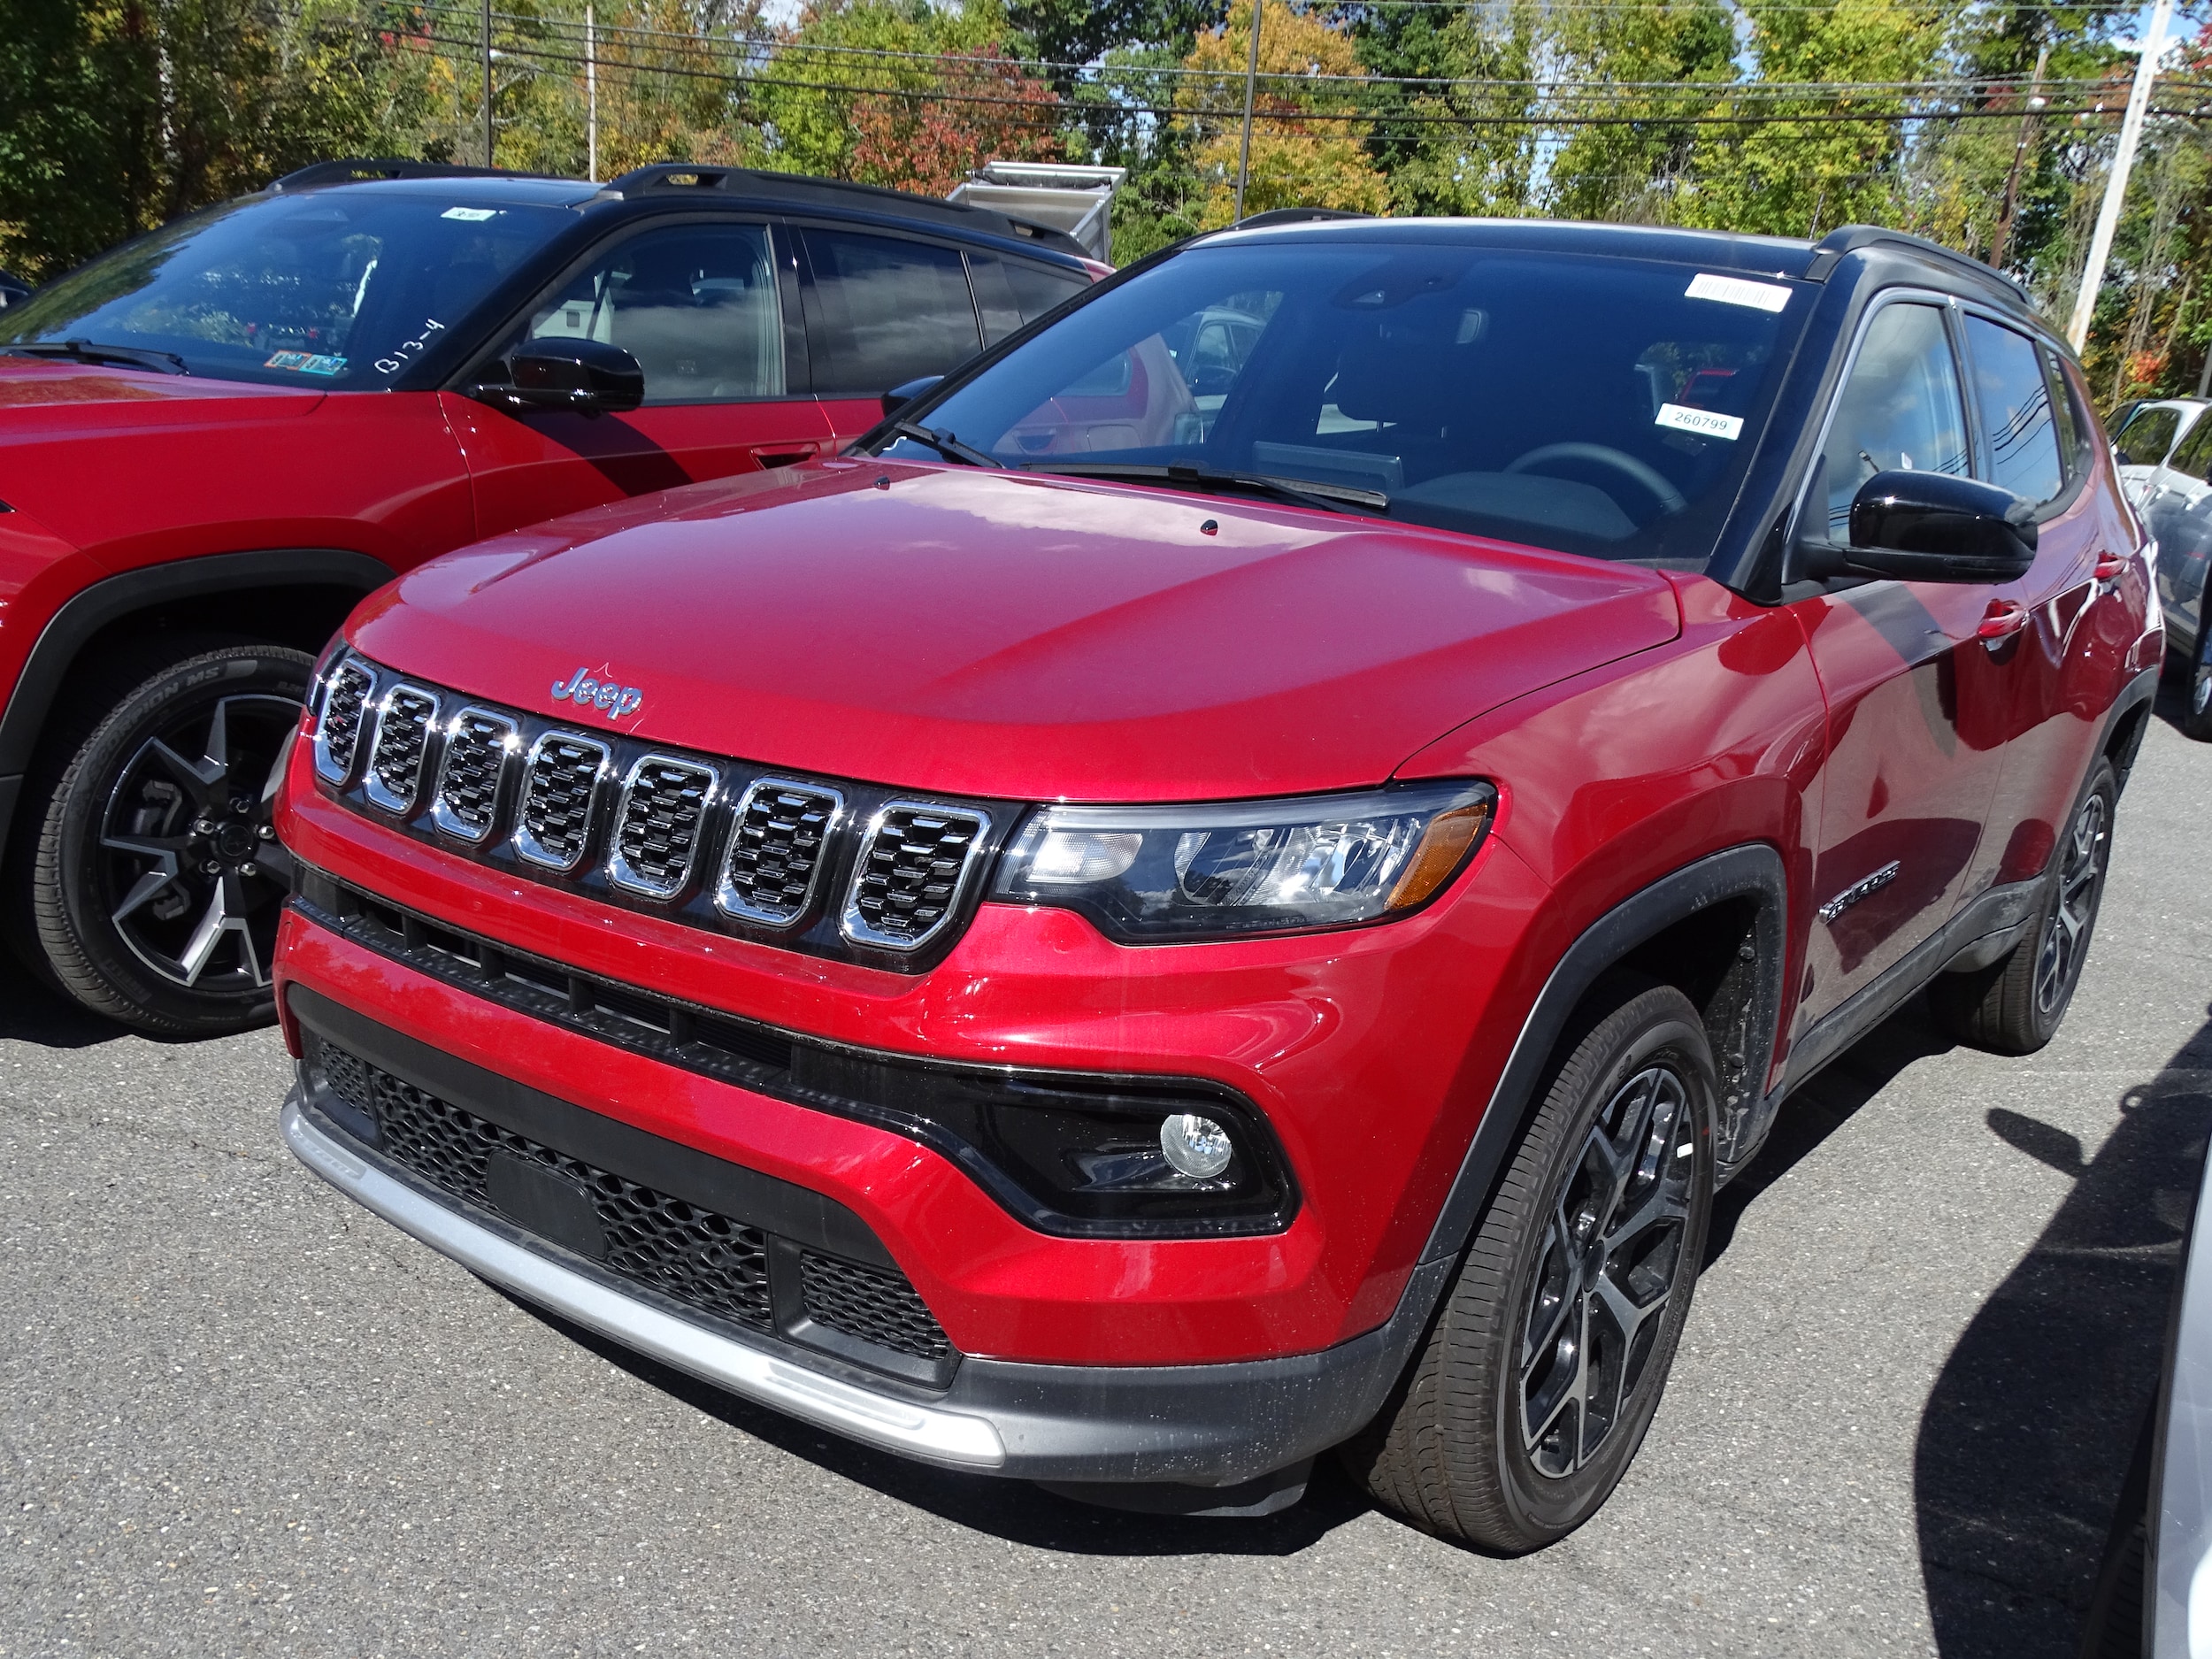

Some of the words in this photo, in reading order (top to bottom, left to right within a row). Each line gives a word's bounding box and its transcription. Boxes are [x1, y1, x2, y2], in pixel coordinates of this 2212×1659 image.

[374, 319, 445, 373] B13-4
[1674, 411, 1728, 430] 260799
[550, 666, 643, 721] Jeep
[87, 682, 179, 779] SCORPION
[186, 666, 219, 686] MS
